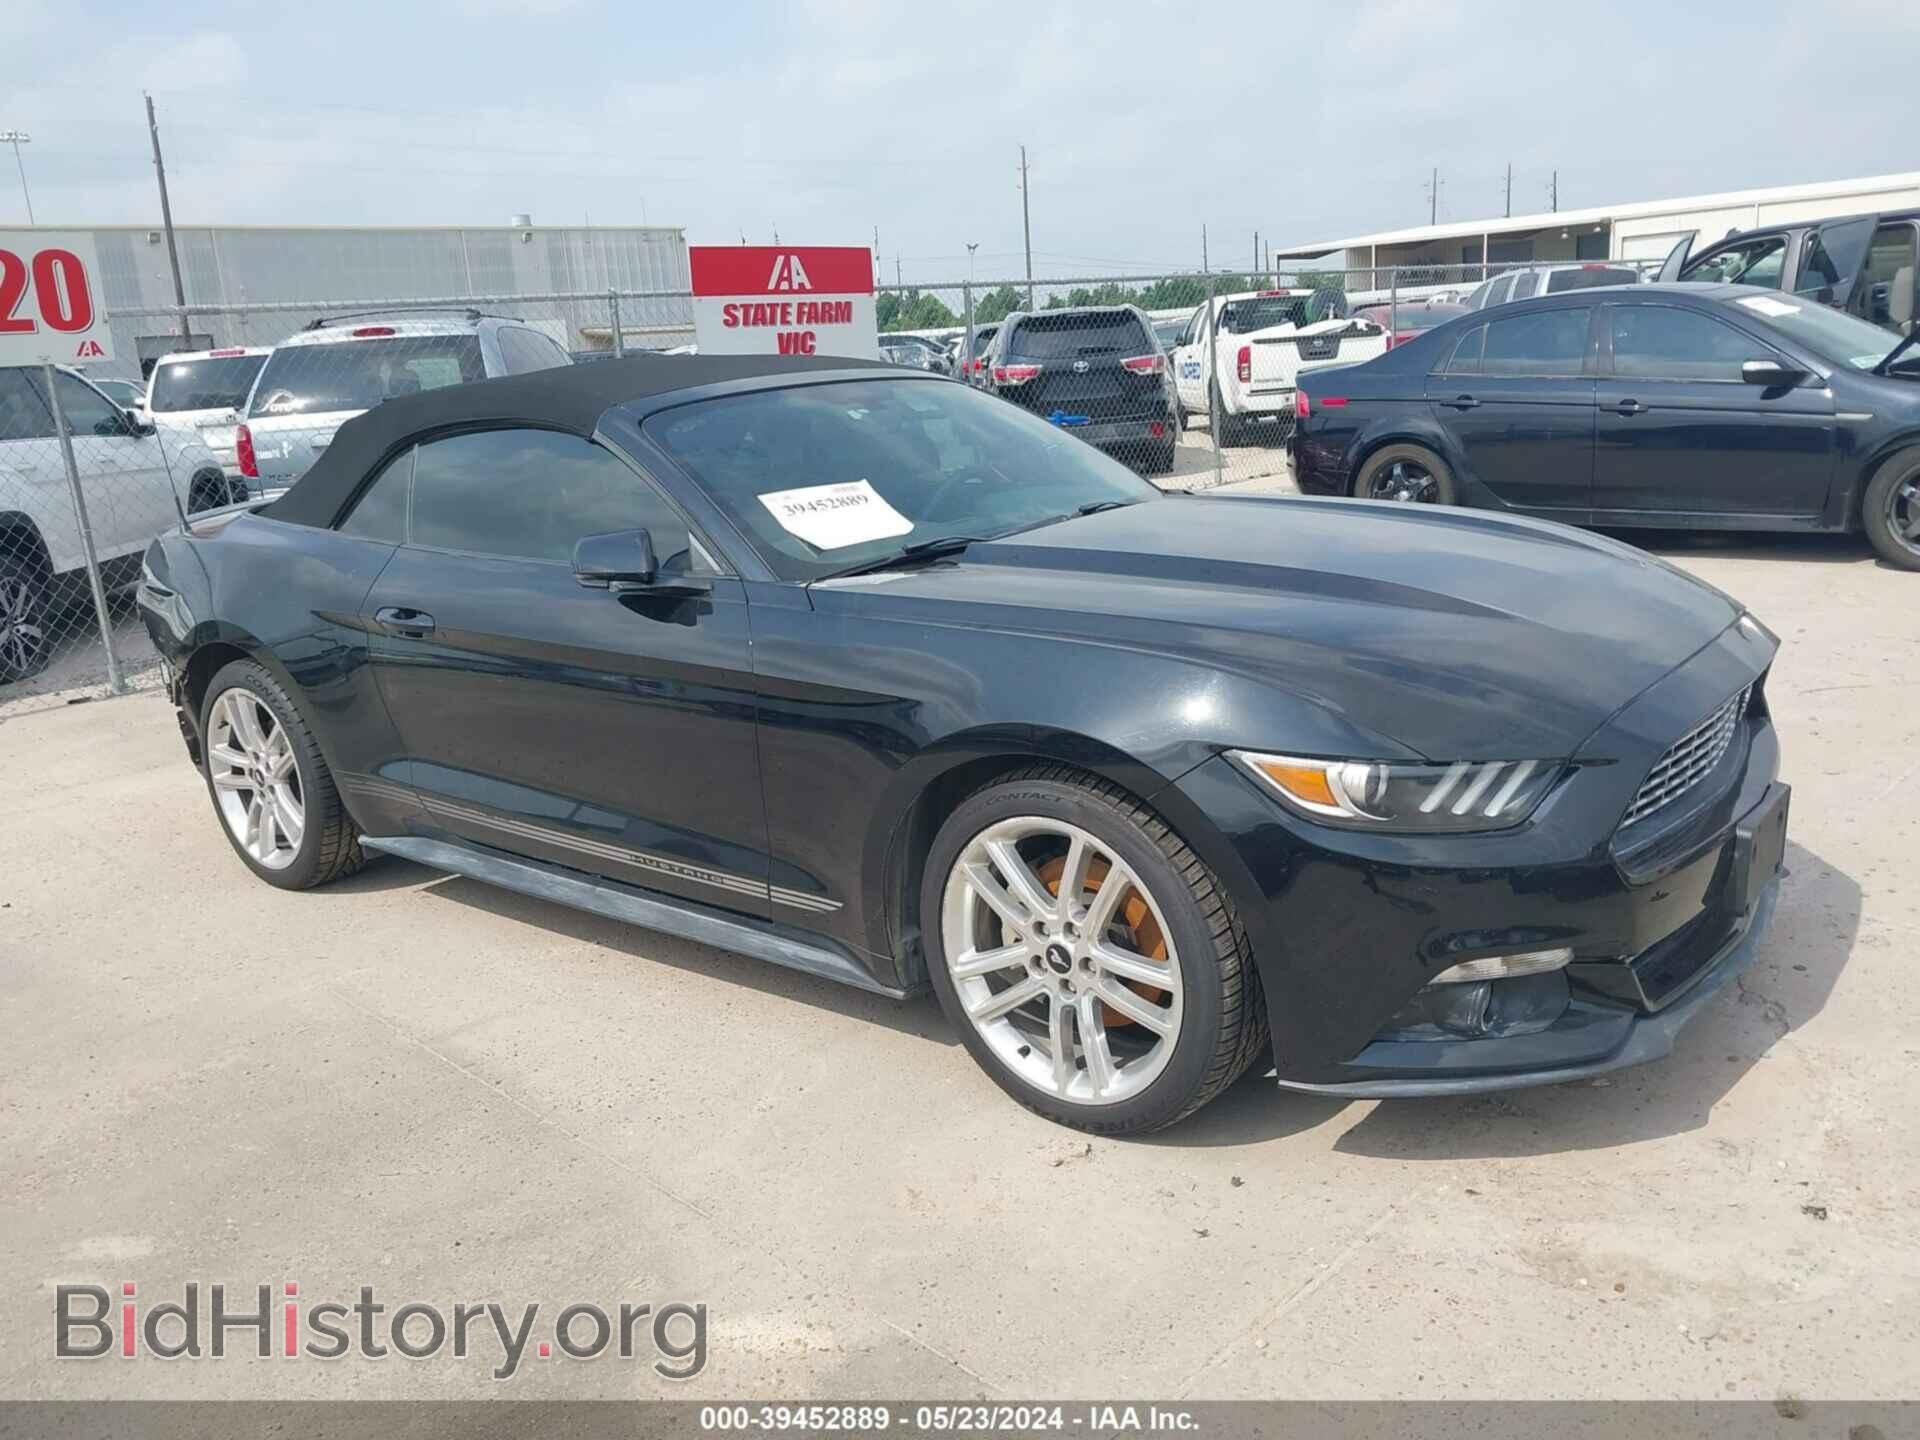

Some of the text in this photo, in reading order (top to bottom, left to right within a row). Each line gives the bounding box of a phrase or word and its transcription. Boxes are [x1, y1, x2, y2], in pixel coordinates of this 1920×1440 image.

[722, 301, 853, 328] STATE FARM
[777, 331, 816, 356] VIC
[784, 494, 869, 517] 39452889
